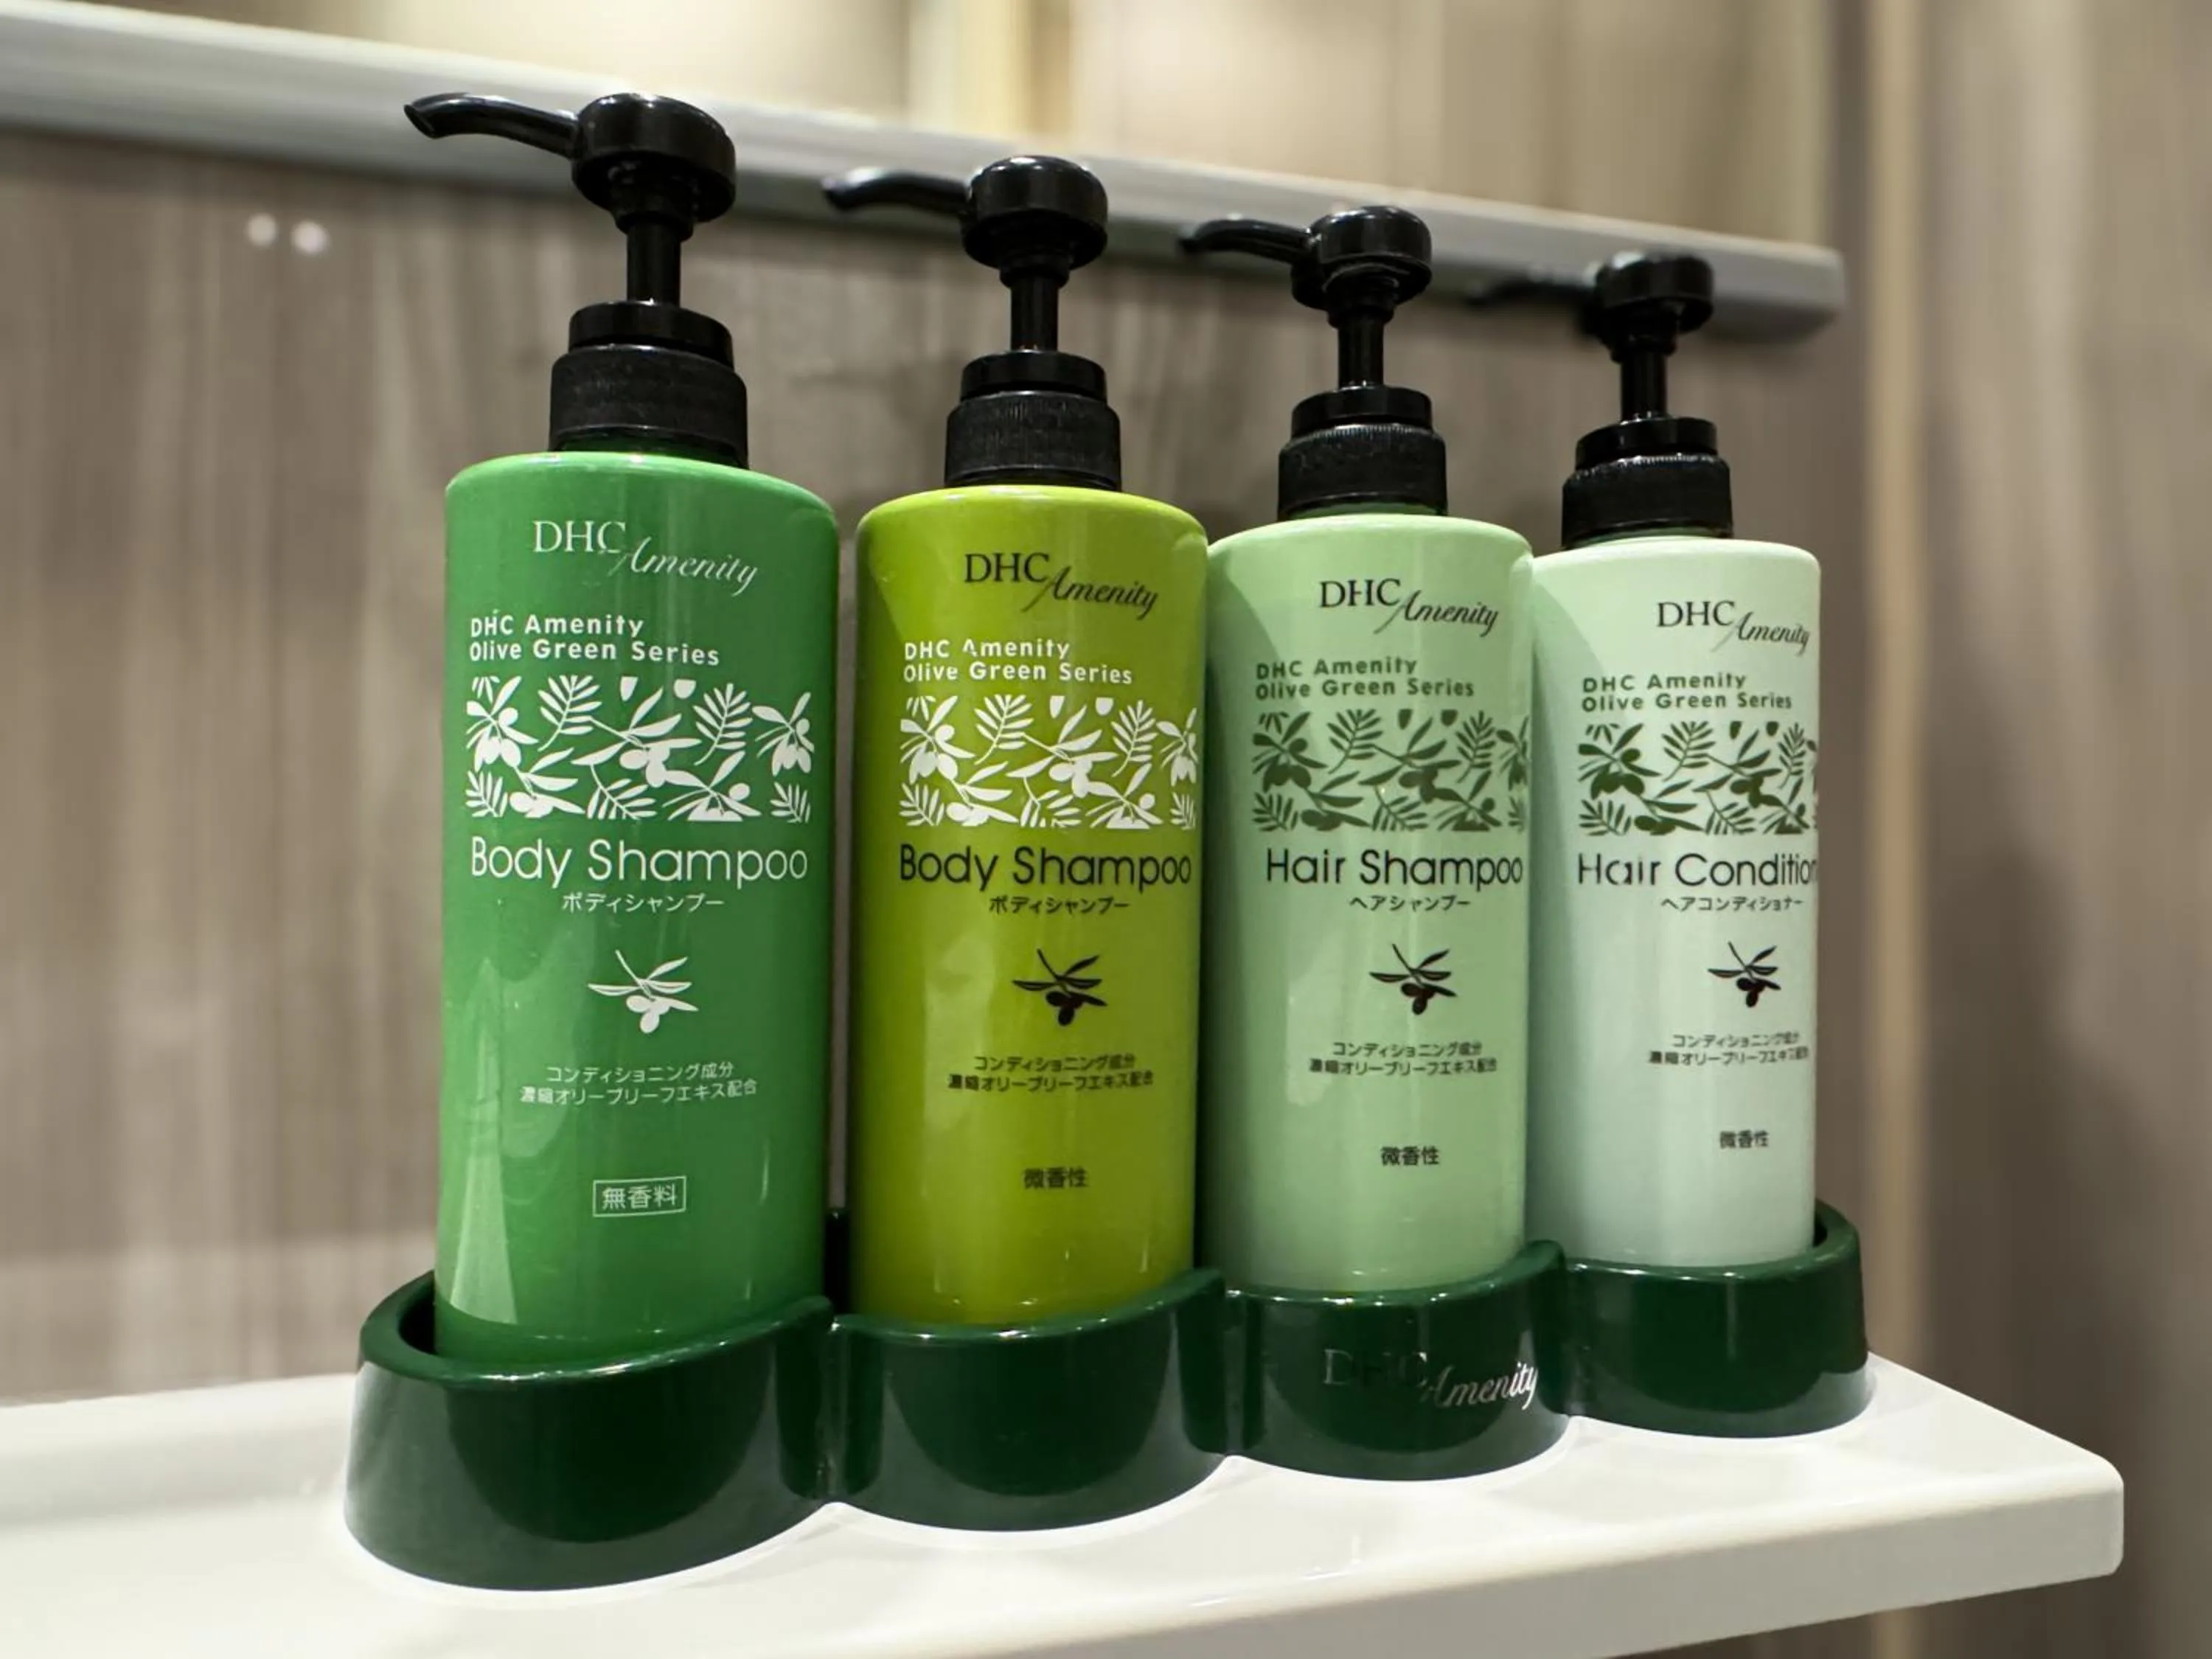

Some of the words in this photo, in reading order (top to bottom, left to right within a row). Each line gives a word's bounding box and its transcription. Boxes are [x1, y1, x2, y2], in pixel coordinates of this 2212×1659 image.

[533, 520, 626, 552] DHC
[608, 536, 758, 597] Amenity
[964, 552, 1051, 583] DHC
[1020, 566, 1158, 620] Amenity
[1319, 578, 1400, 608] DHC
[1373, 590, 1498, 637] Amenity
[470, 614, 514, 636] DHC
[525, 614, 644, 639] Amenity
[1657, 600, 1735, 627] DHC
[1710, 611, 1810, 656] Amenity
[470, 641, 521, 661] Olive
[533, 641, 616, 660] Green
[631, 642, 720, 665] Series
[905, 641, 950, 660] DHC
[963, 638, 1070, 660] Amenity
[904, 663, 958, 683] Olive
[970, 661, 1046, 681] Green
[1059, 663, 1133, 685] Series
[1256, 661, 1301, 680] DHC
[1314, 657, 1417, 676] Amenity
[1256, 682, 1310, 700] Olive
[1322, 680, 1395, 697] Green
[1408, 678, 1475, 697] Series
[1583, 675, 1635, 693] DHC
[1647, 672, 1747, 689] Amenity
[1582, 695, 1644, 712] Olive
[1656, 693, 1725, 709] Green
[1738, 692, 1792, 709] Series
[471, 836, 571, 888] Body
[588, 839, 807, 889] Shampoo
[900, 844, 998, 891] Body
[1013, 846, 1192, 893] Shampoo
[1267, 848, 1346, 883] Hair
[1360, 849, 1523, 891] Shampoo
[1579, 853, 1660, 885] Hair
[563, 891, 724, 913] ボディシャンプー
[990, 896, 1130, 914] ボディシャンプー
[1350, 894, 1470, 911] ヘアシャンプー
[1381, 1146, 1439, 1166] 微香性
[602, 1184, 677, 1210] 無香料
[1419, 1361, 1539, 1410] Amenity
